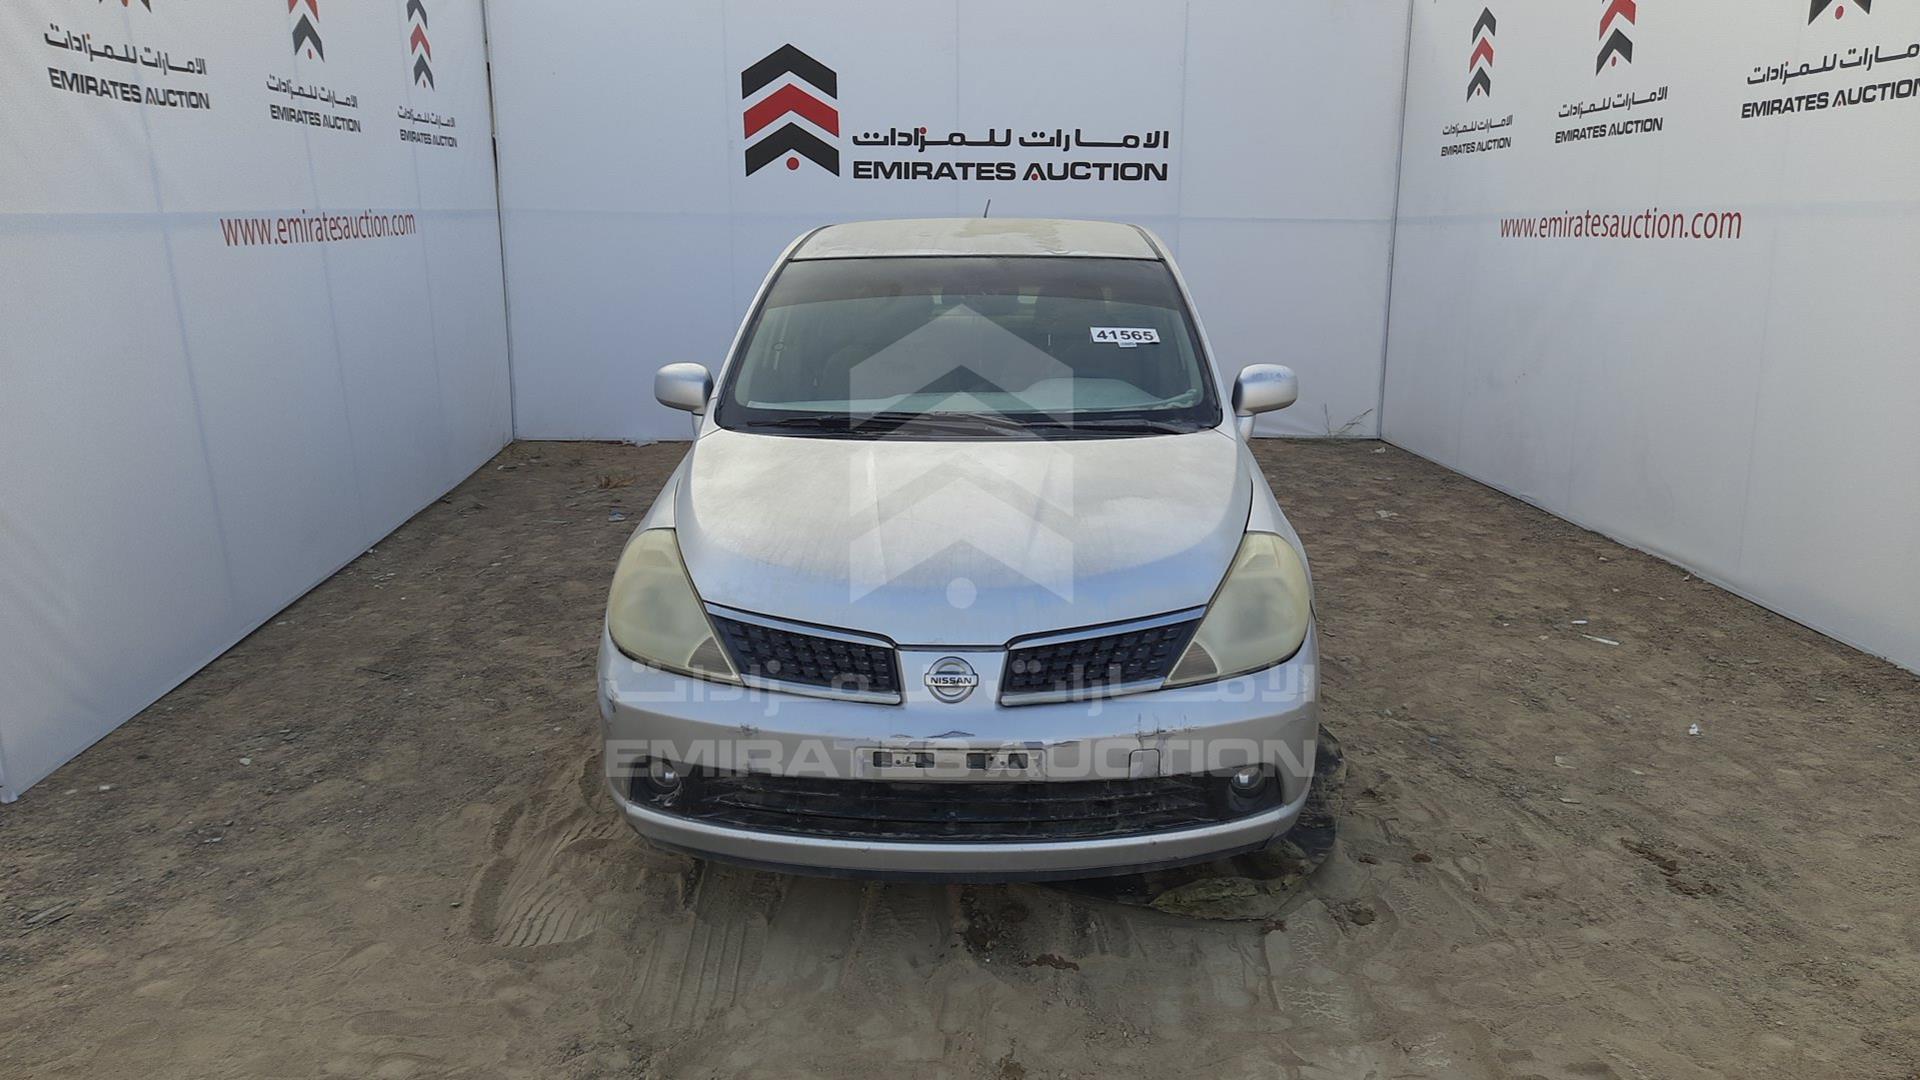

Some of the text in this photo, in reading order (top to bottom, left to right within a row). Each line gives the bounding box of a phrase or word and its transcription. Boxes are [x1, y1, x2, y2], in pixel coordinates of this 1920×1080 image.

[47, 67, 211, 109] EMIRATES AUCTION
[269, 104, 361, 133] EMIRATES AUCTION
[1741, 91, 1830, 119] EMIRATES
[400, 129, 458, 148] EMIRATES AUCTION
[1554, 117, 1663, 144] EMIRATES AUCTION
[1440, 136, 1512, 157] EMIRATES AUCTION
[853, 160, 1168, 182] EMIRATES AUCTION
[220, 209, 417, 248] www.emiratesauction.com
[1500, 207, 1743, 240] www.emiratesauction.com
[1096, 330, 1154, 341] 41565
[930, 676, 973, 685] NISSAN
